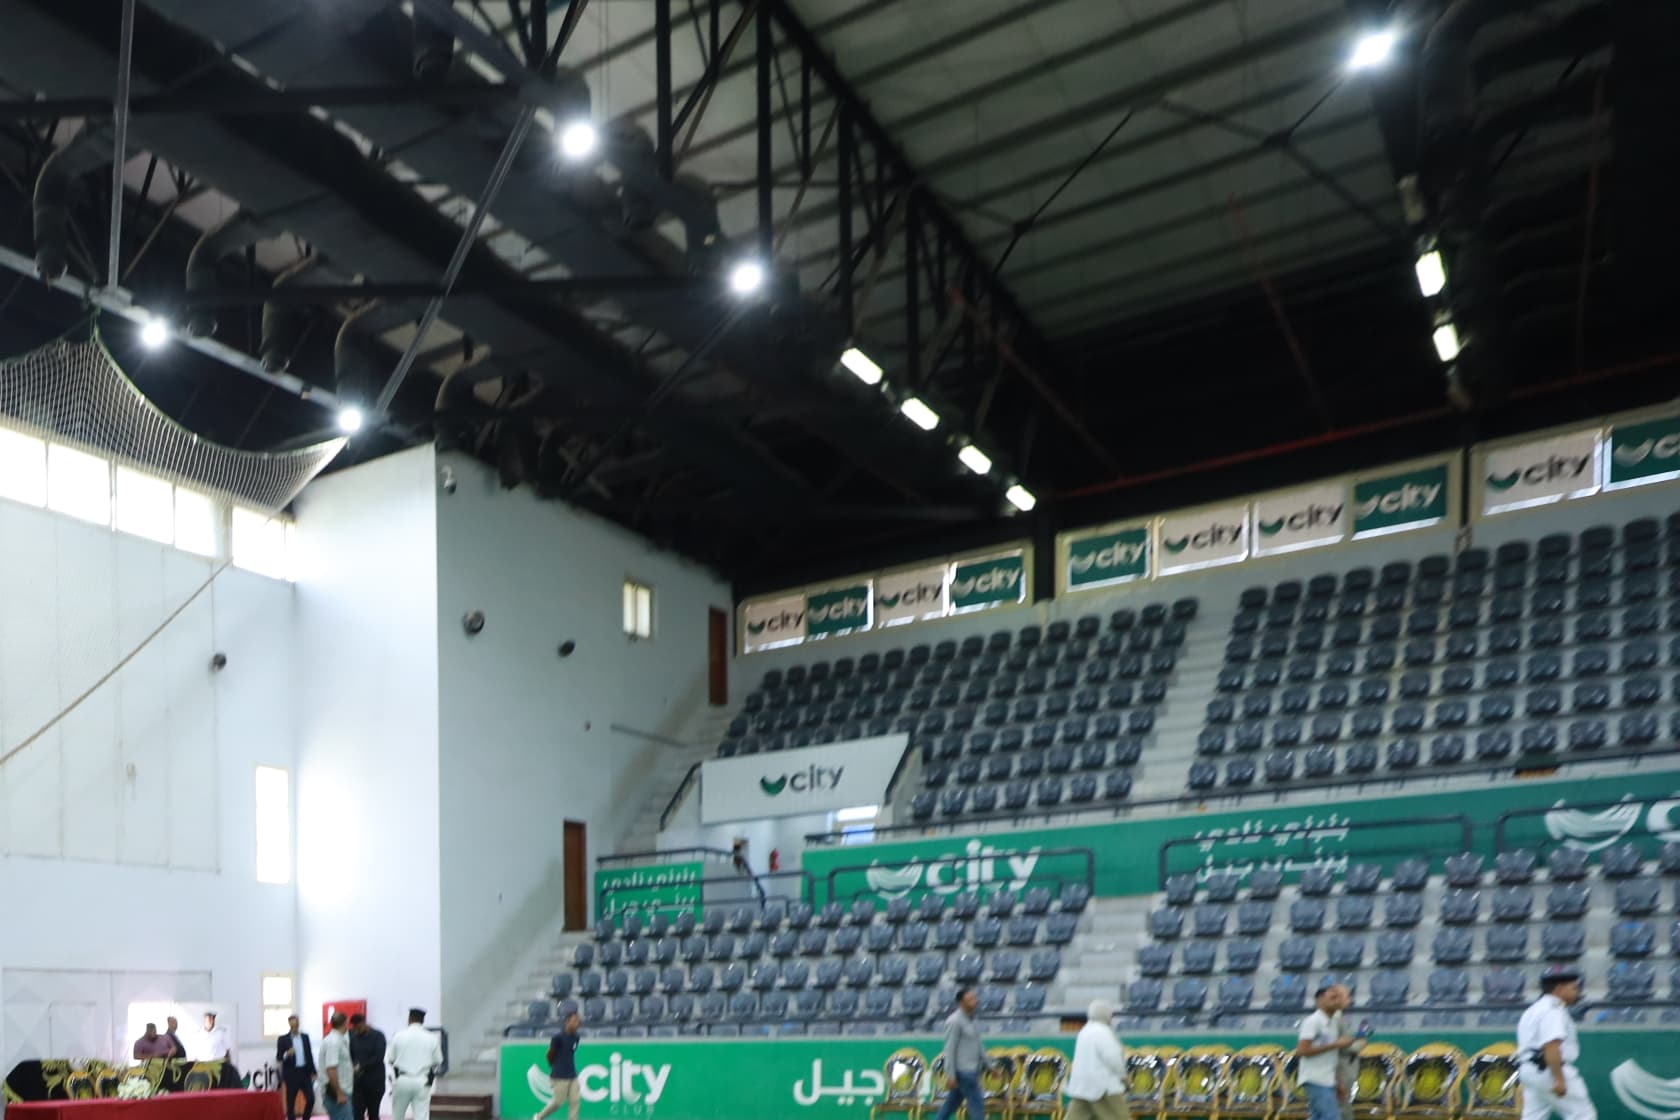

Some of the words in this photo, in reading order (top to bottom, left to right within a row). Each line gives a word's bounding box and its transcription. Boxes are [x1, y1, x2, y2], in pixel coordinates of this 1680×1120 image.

[1523, 452, 1590, 485] city
[1380, 481, 1442, 512] city
[1287, 502, 1344, 532] city
[1191, 521, 1243, 550] city
[1095, 538, 1144, 567] city
[902, 582, 942, 605] city
[975, 567, 1019, 592] city
[767, 609, 805, 632] city
[789, 763, 844, 793] city
[926, 839, 1042, 894] city
[577, 1052, 671, 1105] city
